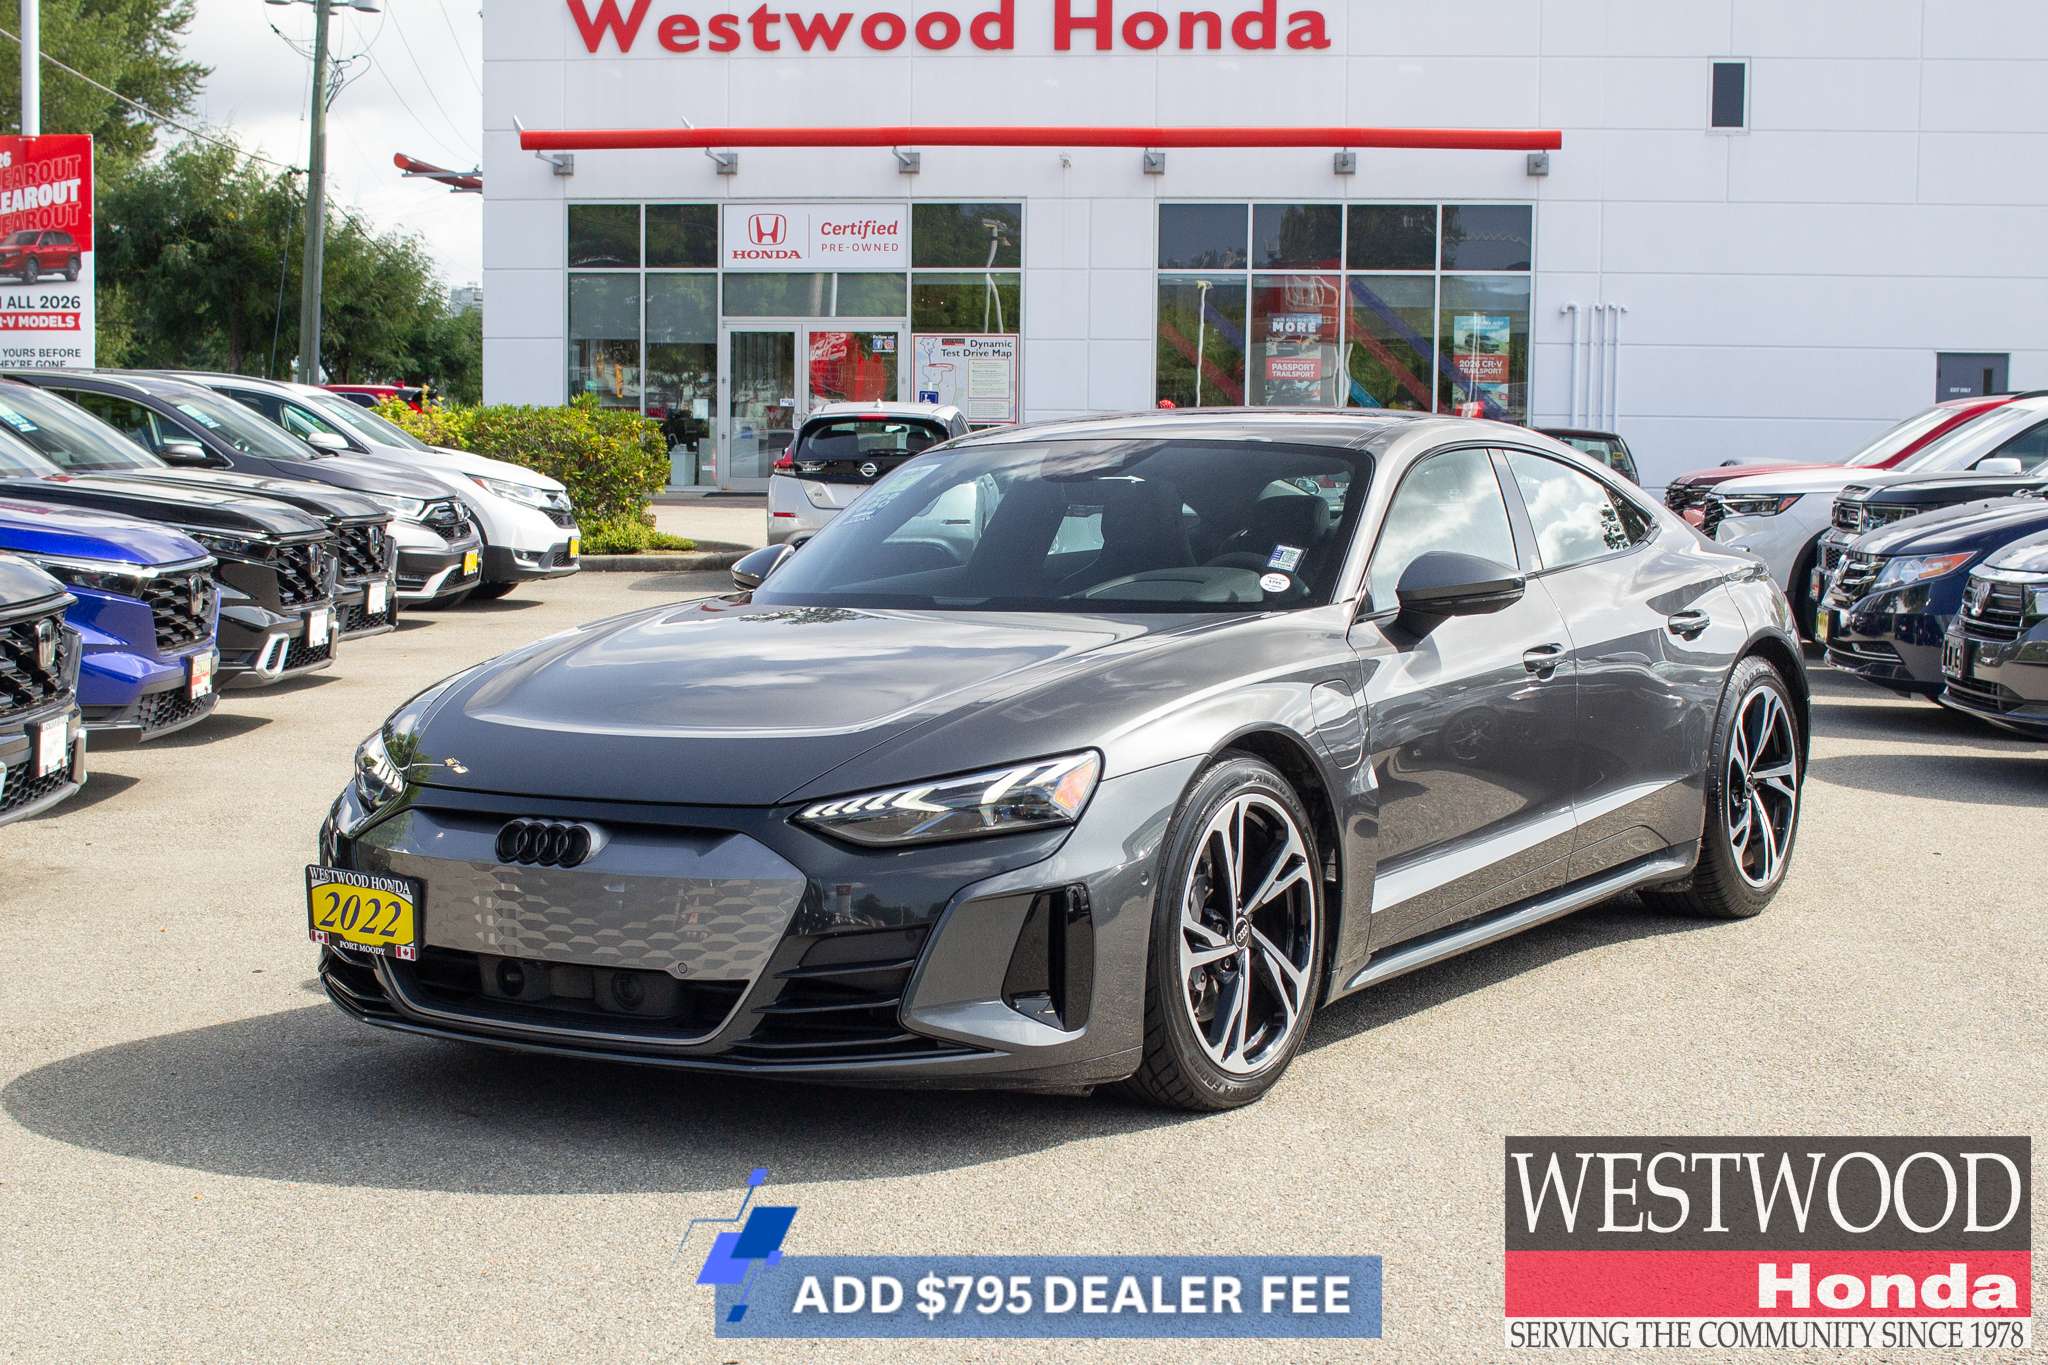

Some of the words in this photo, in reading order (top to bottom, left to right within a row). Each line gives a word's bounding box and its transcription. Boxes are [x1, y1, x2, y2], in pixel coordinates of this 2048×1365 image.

[567, 0, 1014, 53] Westwood
[1053, 0, 1332, 52] Honda
[0, 154, 82, 189] EAROUT
[0, 178, 82, 215] EAROUT
[0, 201, 82, 234] EAROUT
[821, 220, 898, 239] Certified
[821, 243, 899, 252] PRE-OWNED
[732, 250, 801, 260] HONDA
[7, 296, 35, 309] ALL
[40, 296, 81, 309] 2026
[19, 315, 75, 328] MODELS
[1272, 321, 1316, 332] MORE
[970, 340, 1012, 348] Dynamic
[3, 348, 36, 358] YOURS
[39, 348, 82, 358] BEFORE
[941, 349, 960, 357] Test
[963, 349, 989, 357] Drive
[992, 350, 1012, 359] Map
[0, 360, 33, 368] HEY'RE
[1272, 363, 1315, 371] PASSPORT
[309, 866, 369, 888] WESTWOOD
[371, 876, 410, 894] HONDA
[319, 892, 401, 937] 2022
[340, 940, 358, 951] PORT
[359, 945, 385, 955] MOODY
